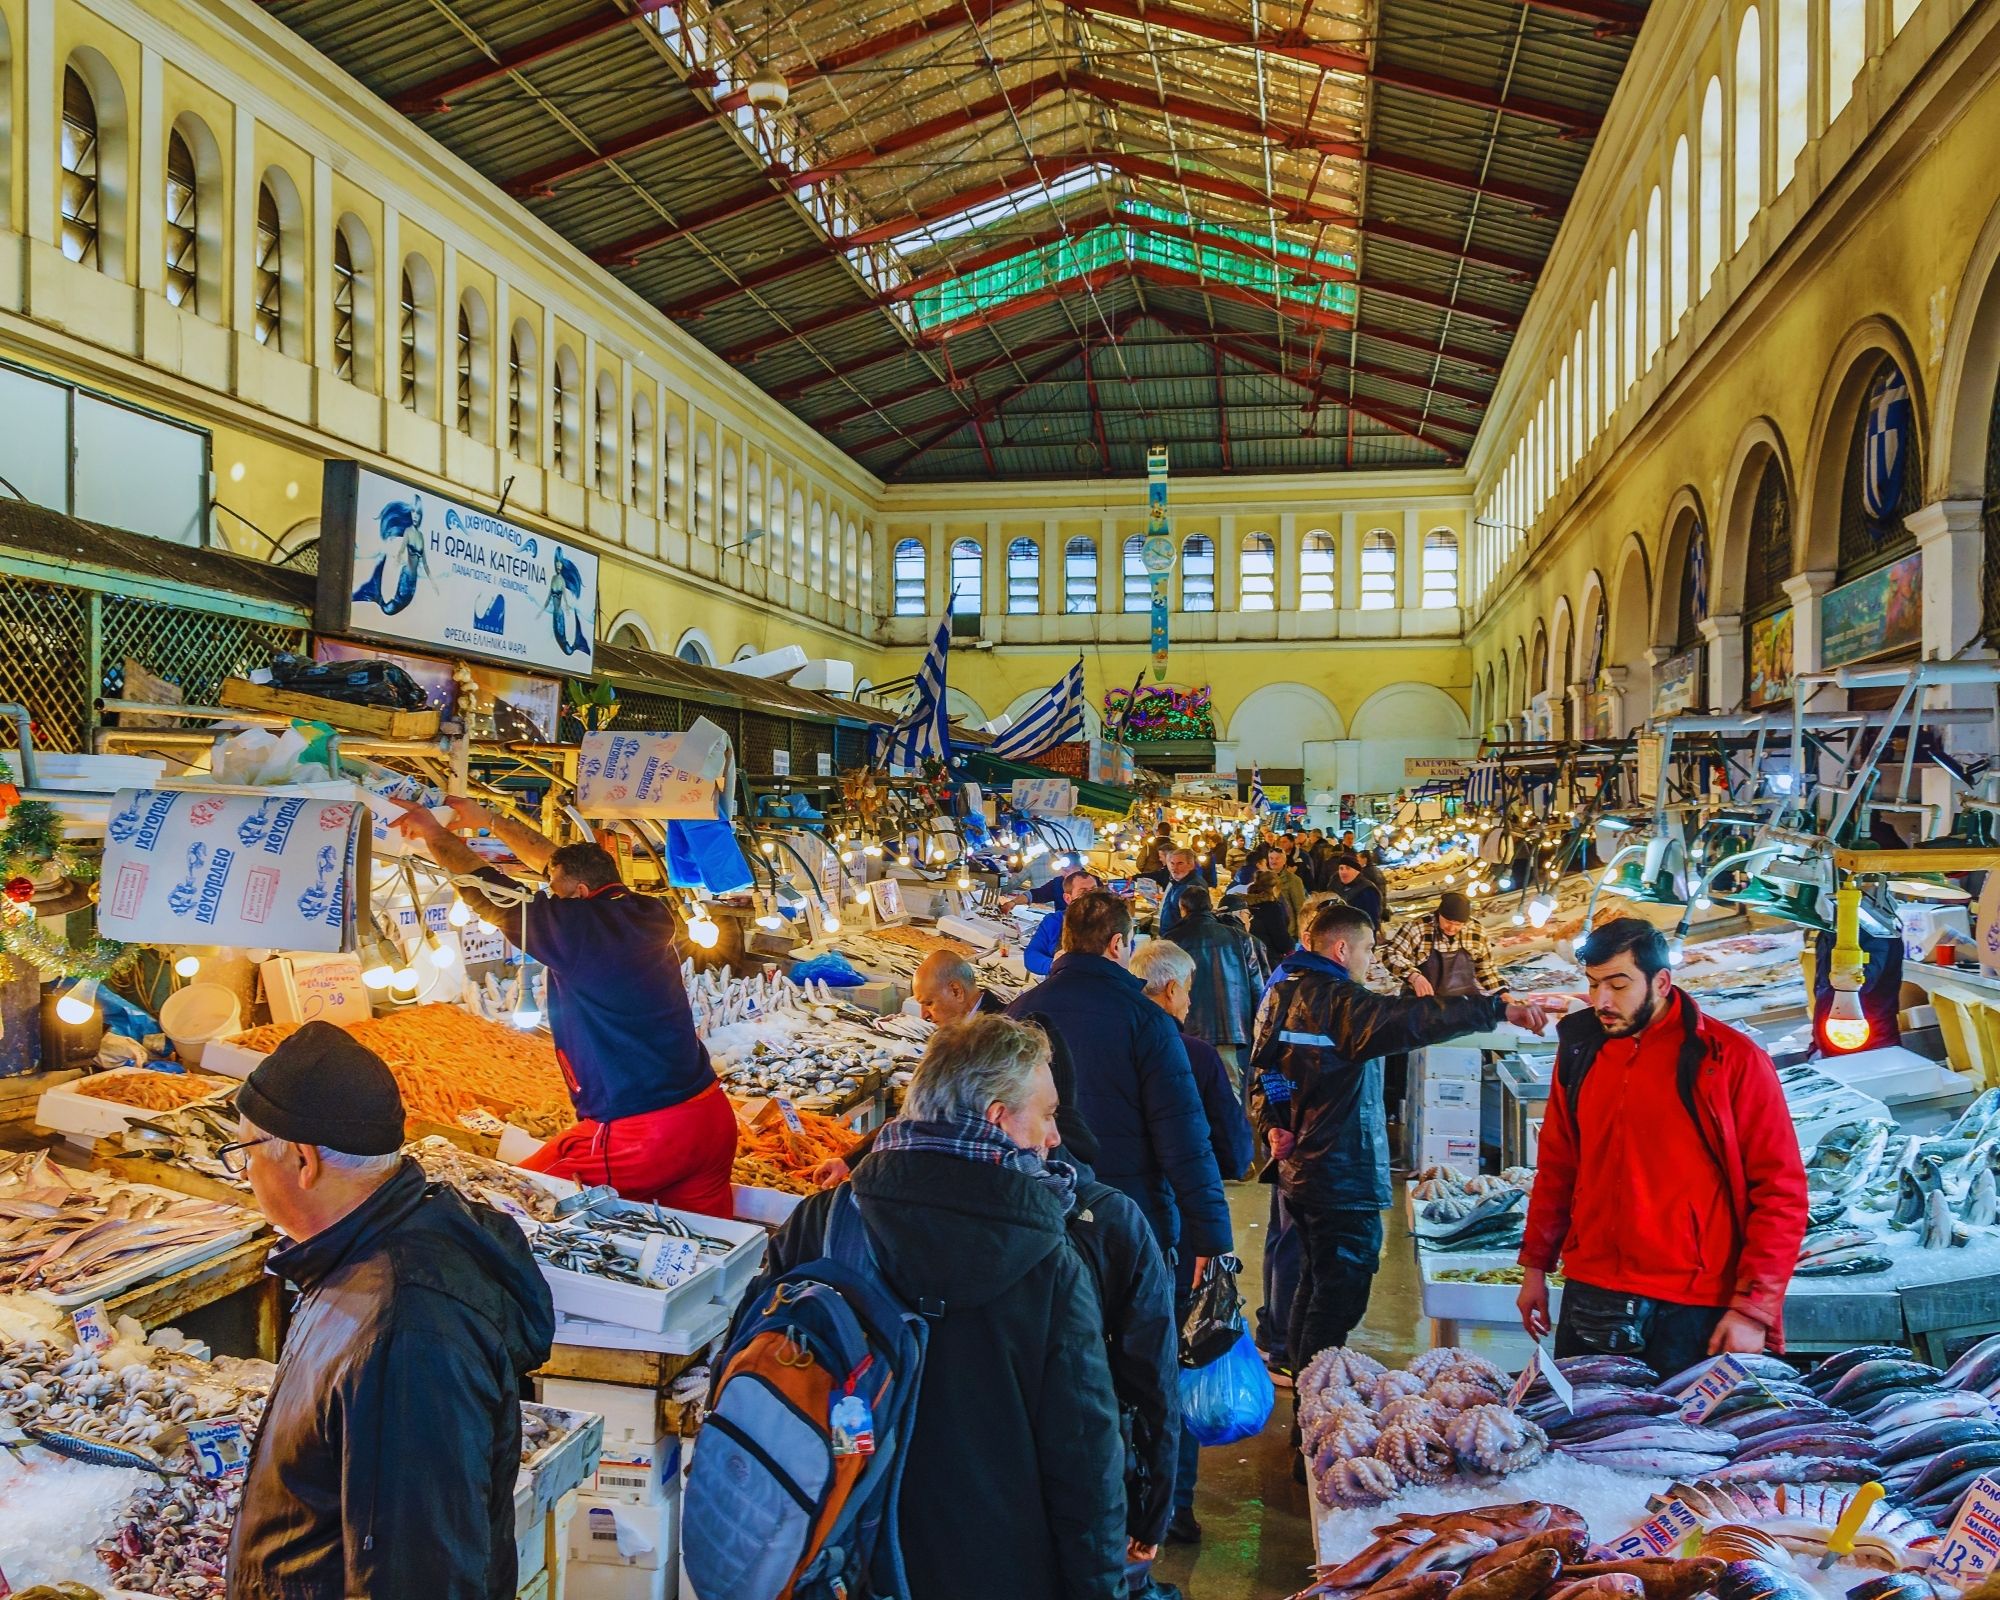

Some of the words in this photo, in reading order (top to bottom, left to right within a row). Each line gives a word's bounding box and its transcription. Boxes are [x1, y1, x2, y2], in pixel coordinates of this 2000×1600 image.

[430, 530, 440, 552] Η
[445, 536, 486, 566] ΩΡΑΙΑ
[490, 549, 547, 585] ΚΑΤΕΡΙΝΑ
[465, 515, 522, 546] ΙΧΘΥΟΠΩΛΕΙΟ
[195, 847, 232, 924] ΙΧΘΥΟΠΩΛΕΙΟ
